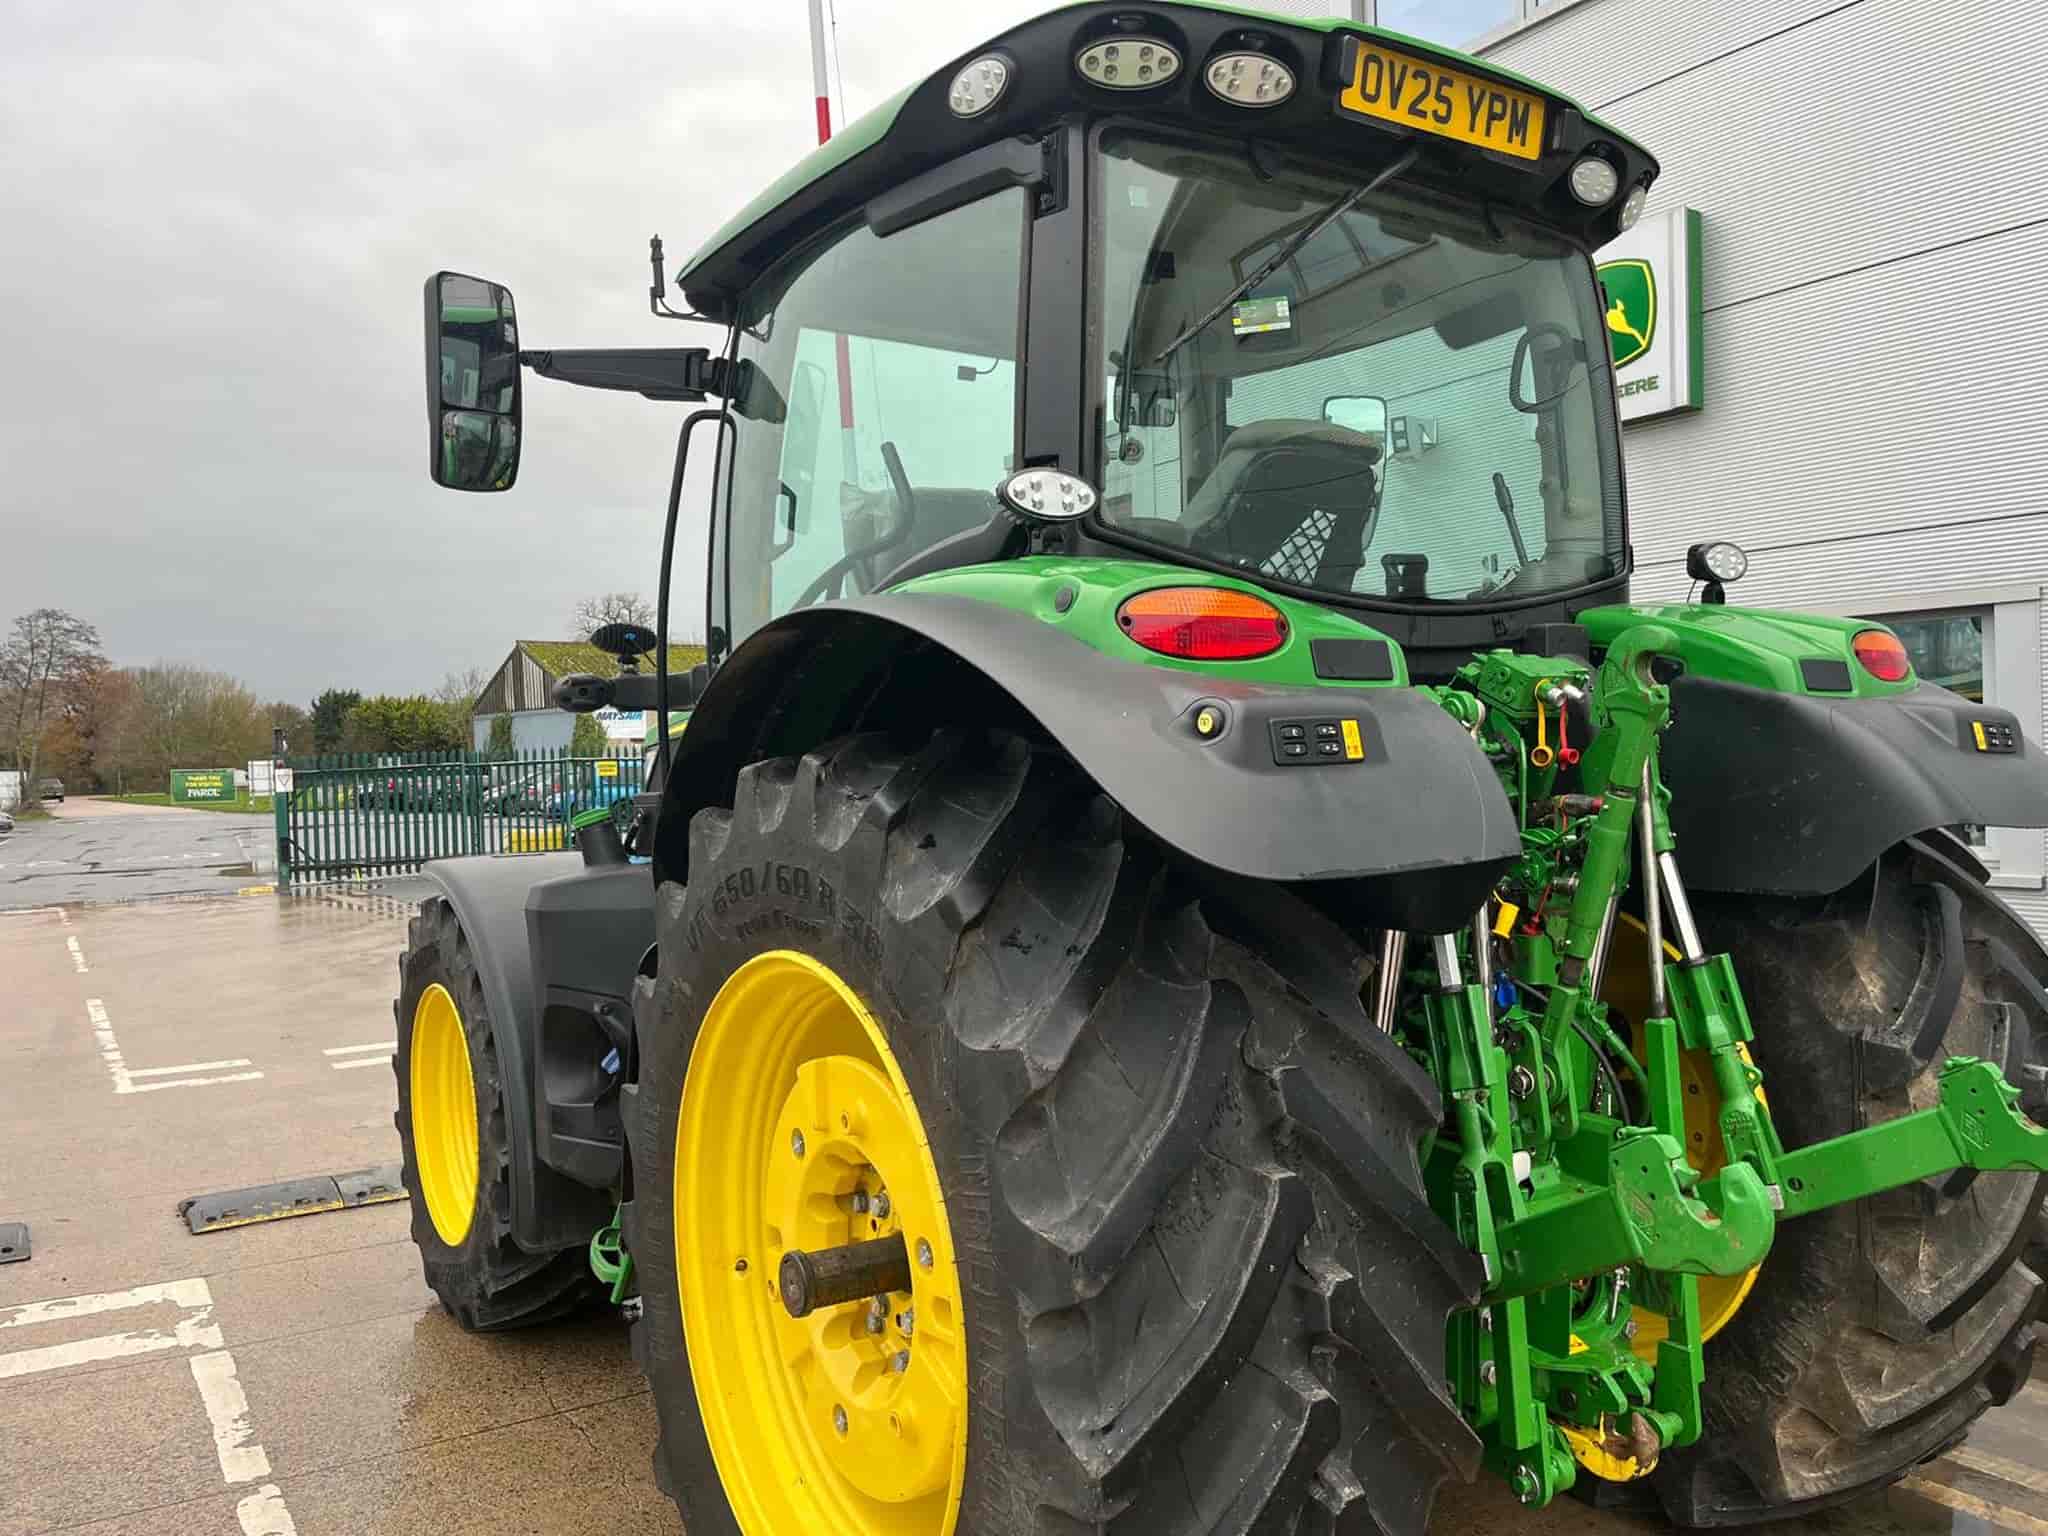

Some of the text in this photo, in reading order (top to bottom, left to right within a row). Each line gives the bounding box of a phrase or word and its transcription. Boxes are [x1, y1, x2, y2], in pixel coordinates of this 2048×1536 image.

[1360, 53, 1531, 147] OV25 YPM
[1616, 374, 1659, 398] EERE
